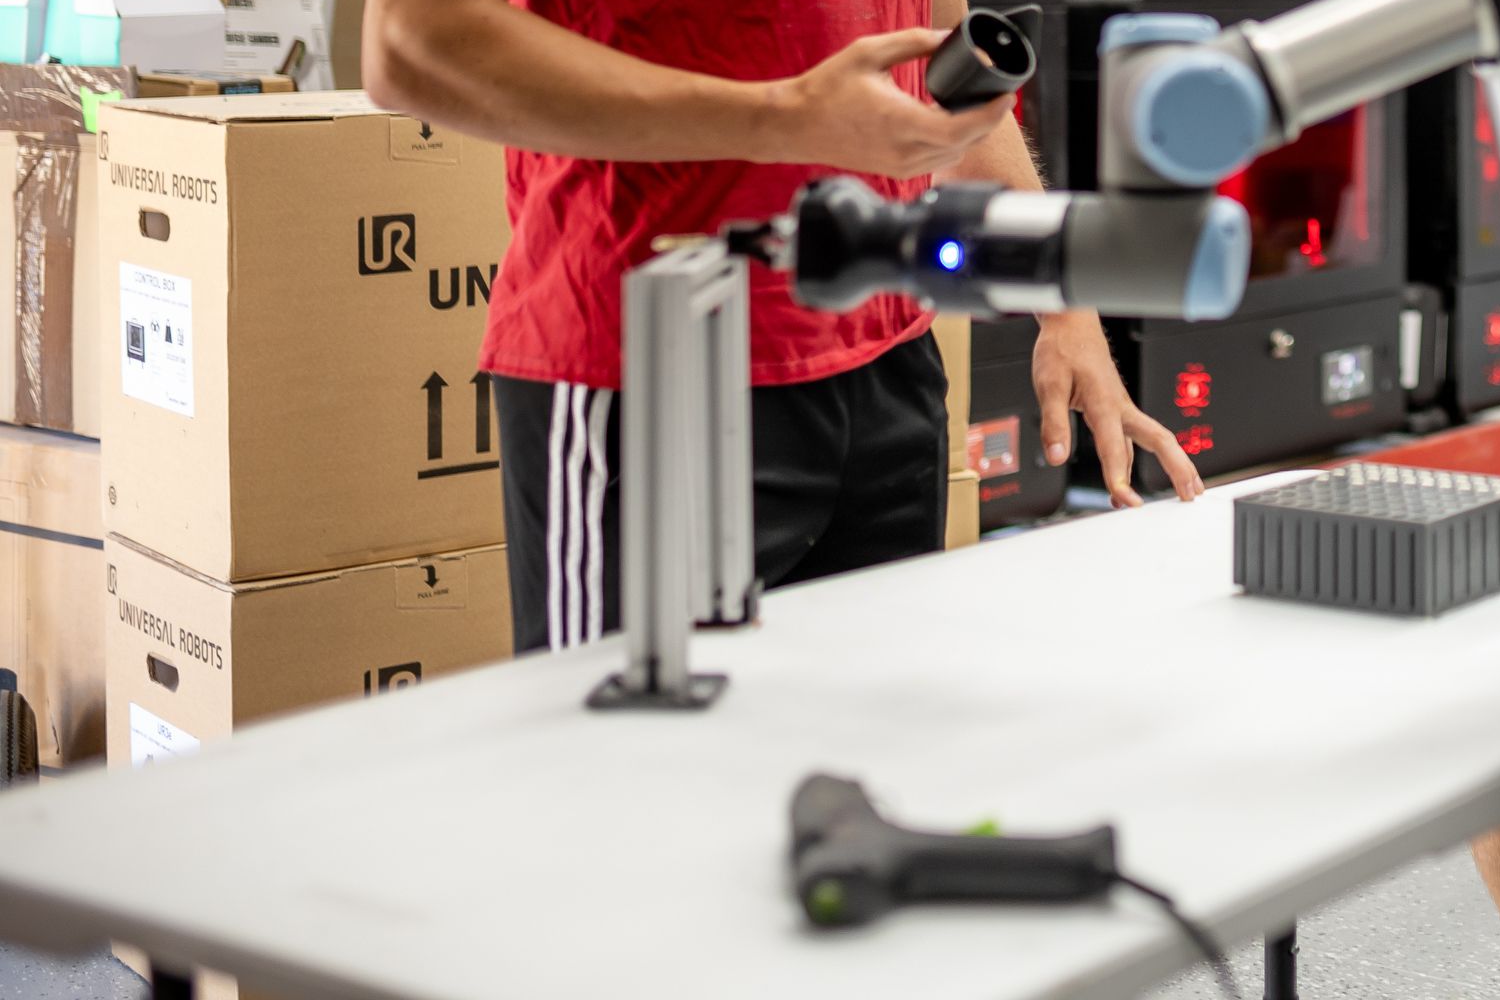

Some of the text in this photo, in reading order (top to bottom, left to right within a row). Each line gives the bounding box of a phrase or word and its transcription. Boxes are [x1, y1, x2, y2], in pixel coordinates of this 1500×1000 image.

[110, 161, 218, 205] UNIVERSAL ROBOTS
[358, 213, 417, 276] UR
[119, 597, 223, 671] UNIVERSAL ROBOTS
